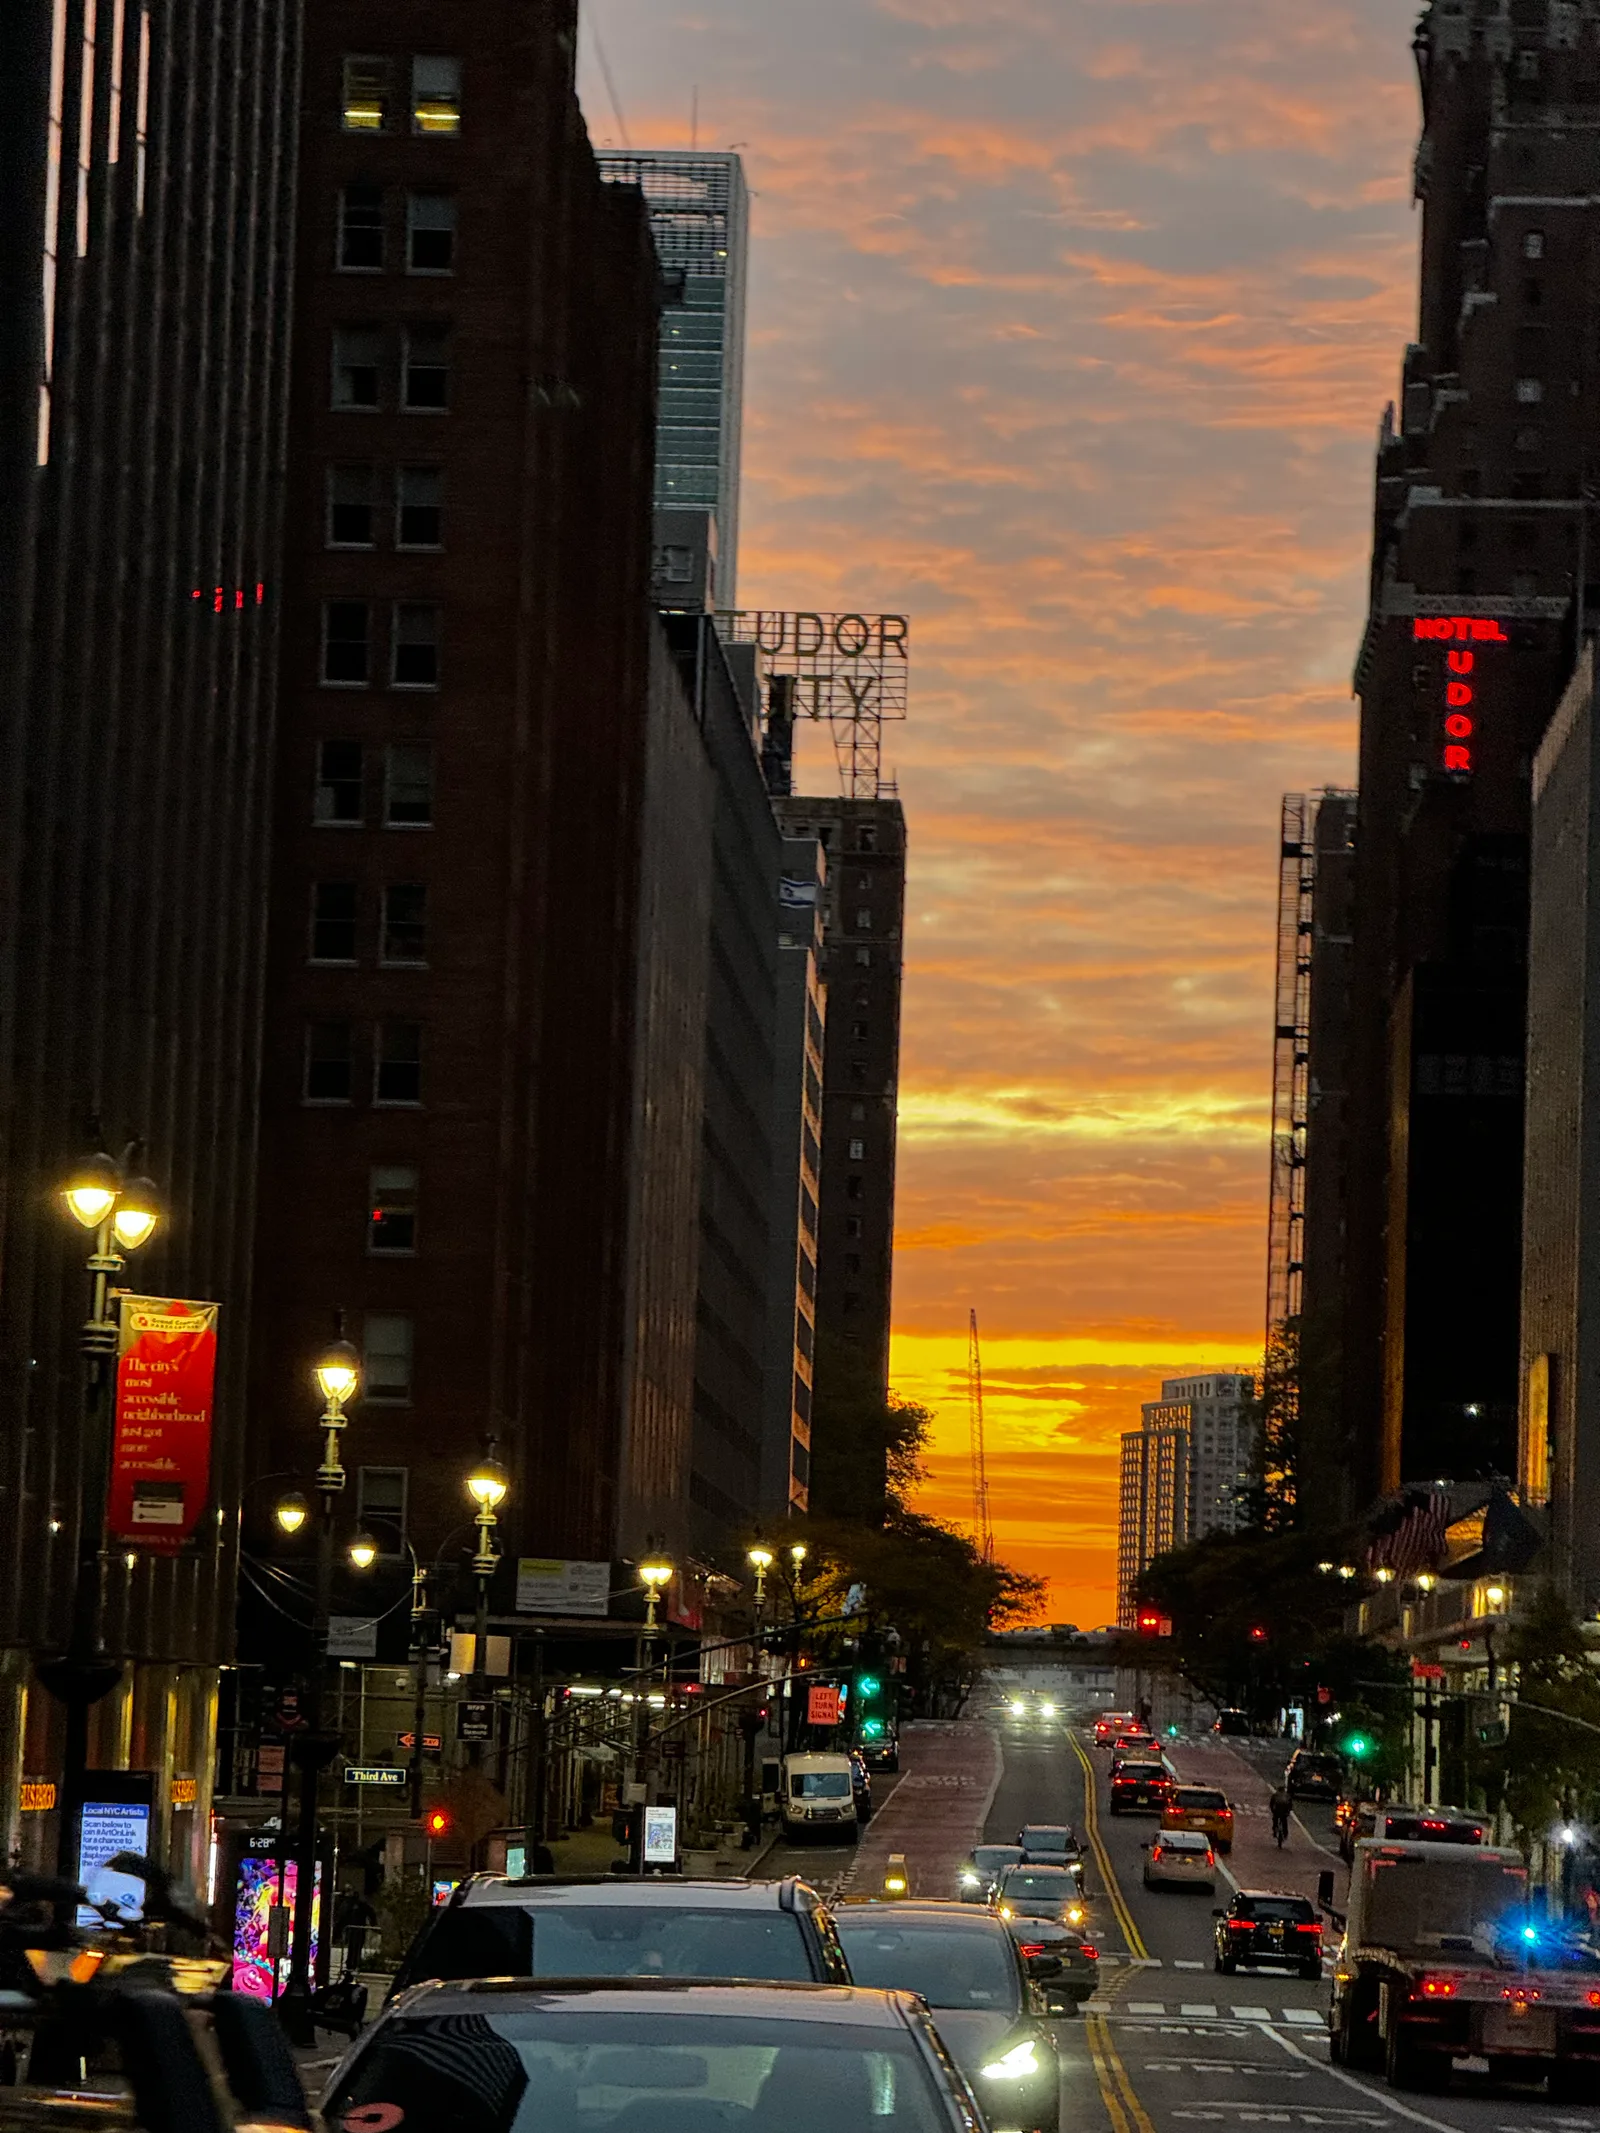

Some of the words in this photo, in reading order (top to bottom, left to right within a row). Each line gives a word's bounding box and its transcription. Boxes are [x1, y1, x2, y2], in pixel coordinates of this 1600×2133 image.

[1414, 617, 1508, 641] HOTEL
[126, 1358, 149, 1372] The
[150, 1359, 179, 1374] city's
[125, 1378, 152, 1388] most
[123, 1392, 180, 1405] accessible
[123, 1407, 206, 1423] neighborhood
[120, 1424, 142, 1438] just
[143, 1427, 163, 1438] got
[815, 1692, 832, 1700] LEFT
[815, 1701, 834, 1709] TURN
[811, 1710, 835, 1719] SIGNAL
[353, 1771, 378, 1781] Third
[380, 1771, 398, 1782] Ave
[84, 1805, 103, 1814] Local
[104, 1806, 121, 1814] NYC
[120, 1806, 145, 1815] Artists
[102, 1820, 123, 1828] below
[96, 1828, 137, 1836] #ArtOnLink
[98, 1836, 125, 1844] chance
[99, 1845, 115, 1853] your
